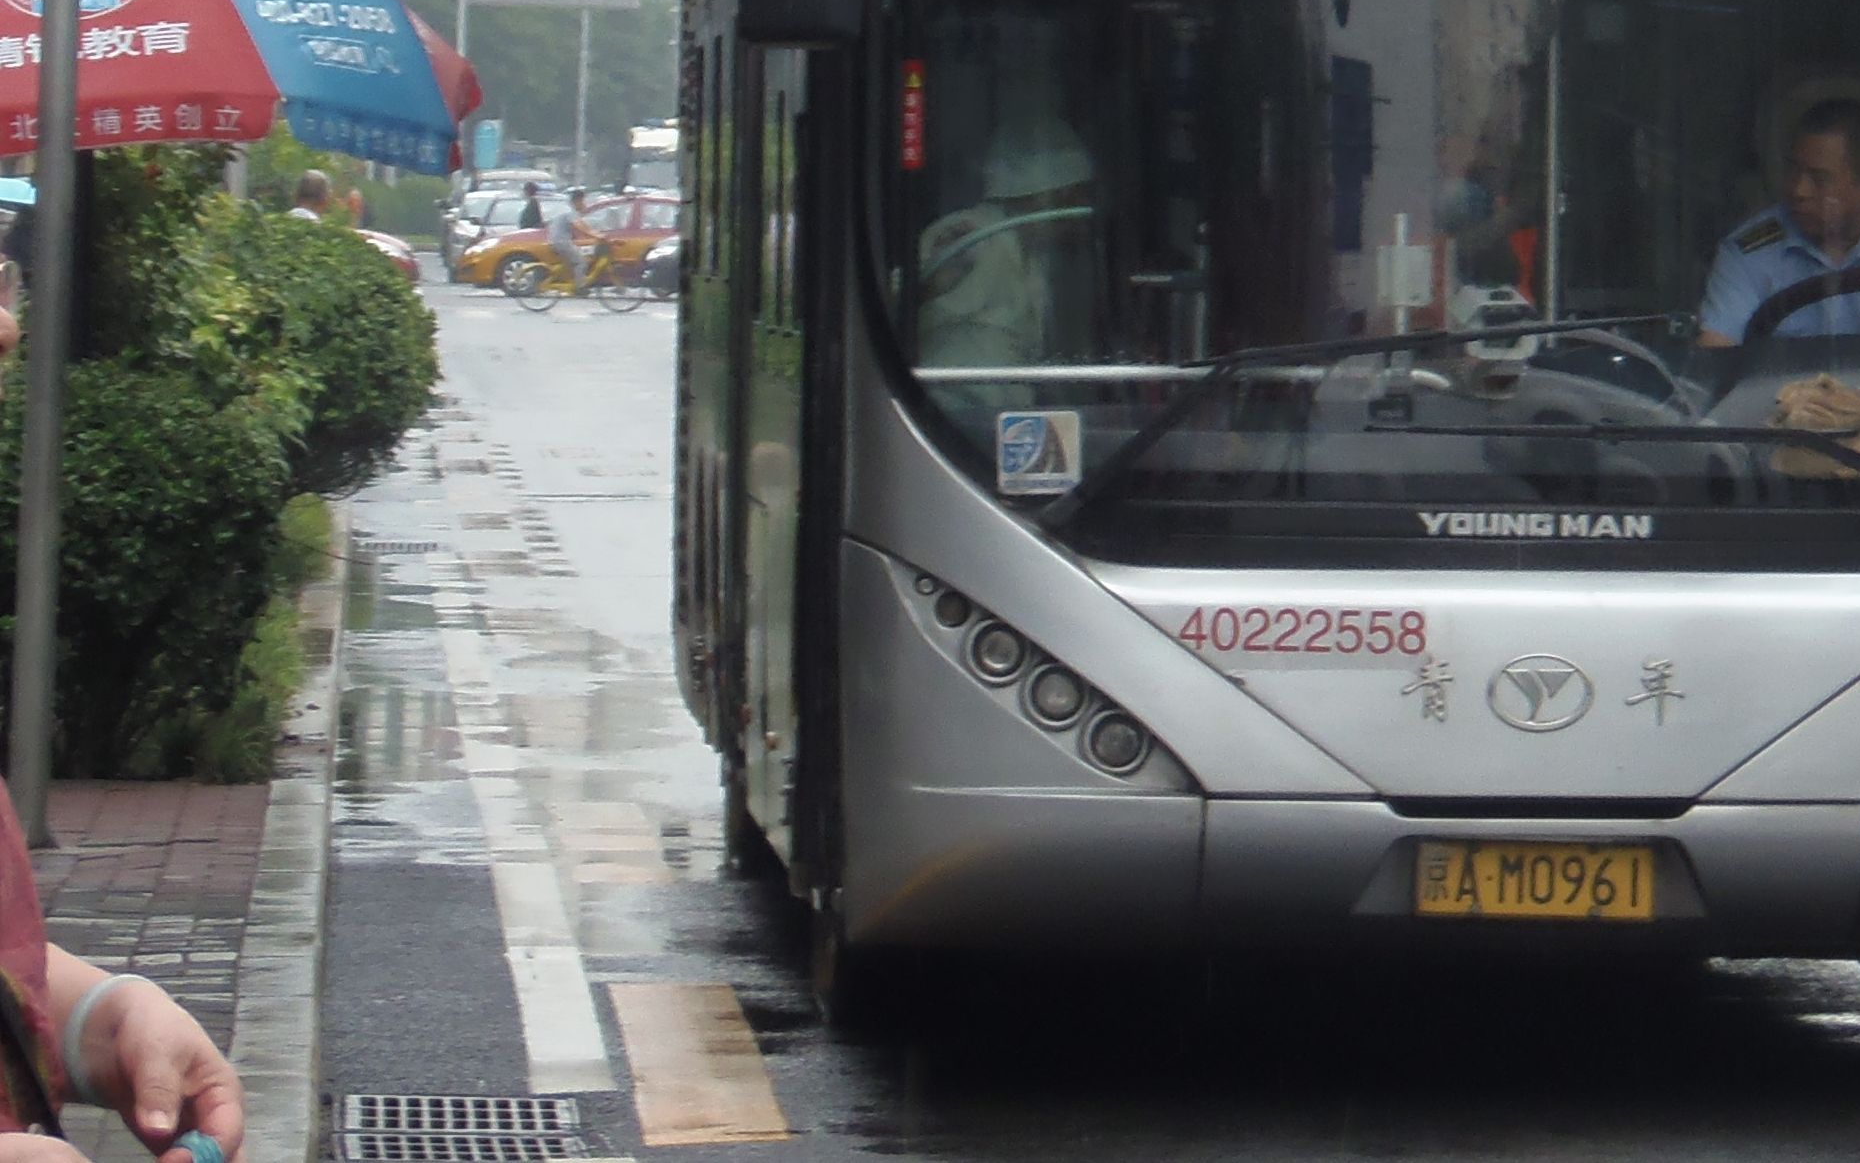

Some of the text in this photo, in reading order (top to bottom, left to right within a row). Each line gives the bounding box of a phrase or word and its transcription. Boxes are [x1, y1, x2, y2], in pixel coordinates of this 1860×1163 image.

[9, 103, 243, 141] 北精英创立
[1179, 605, 1428, 655] 40222558
